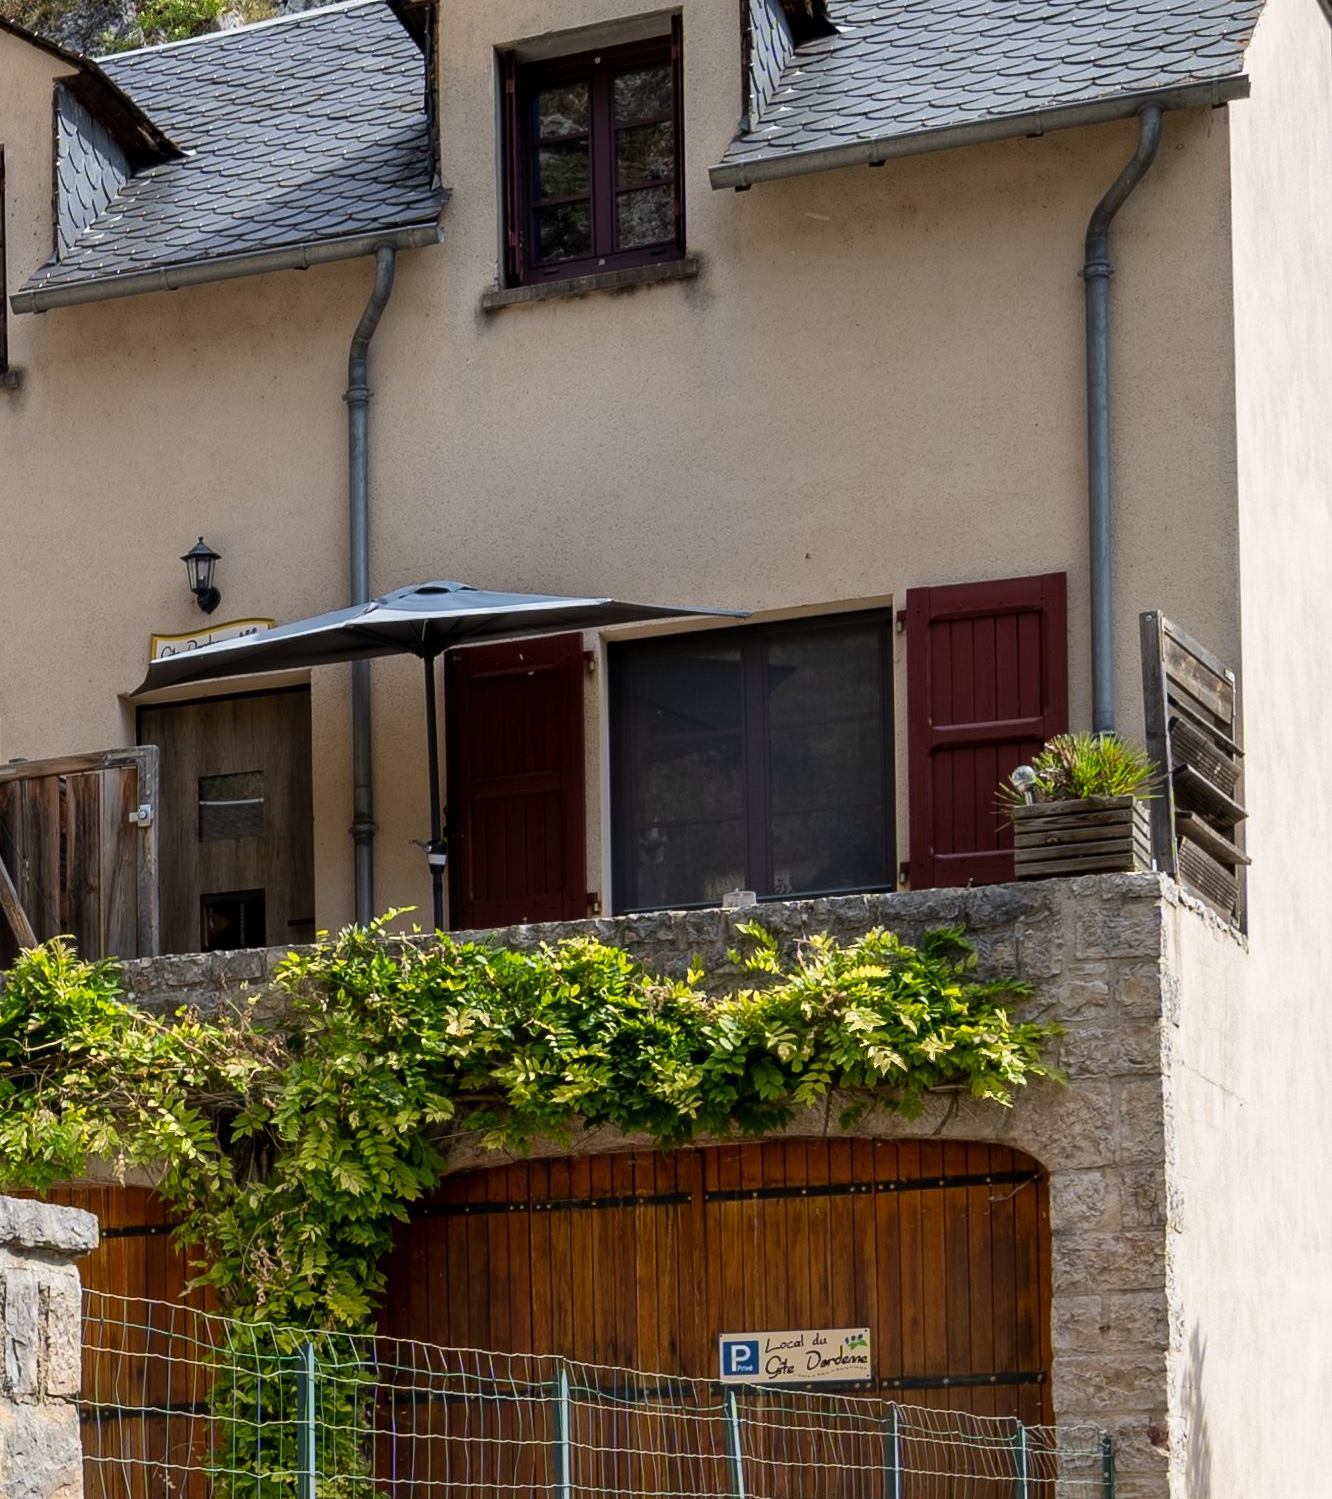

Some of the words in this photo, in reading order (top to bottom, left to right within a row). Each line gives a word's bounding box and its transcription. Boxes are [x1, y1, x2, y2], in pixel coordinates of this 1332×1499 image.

[765, 1334, 804, 1353] Local
[812, 1332, 828, 1345] du
[731, 1345, 751, 1372] P
